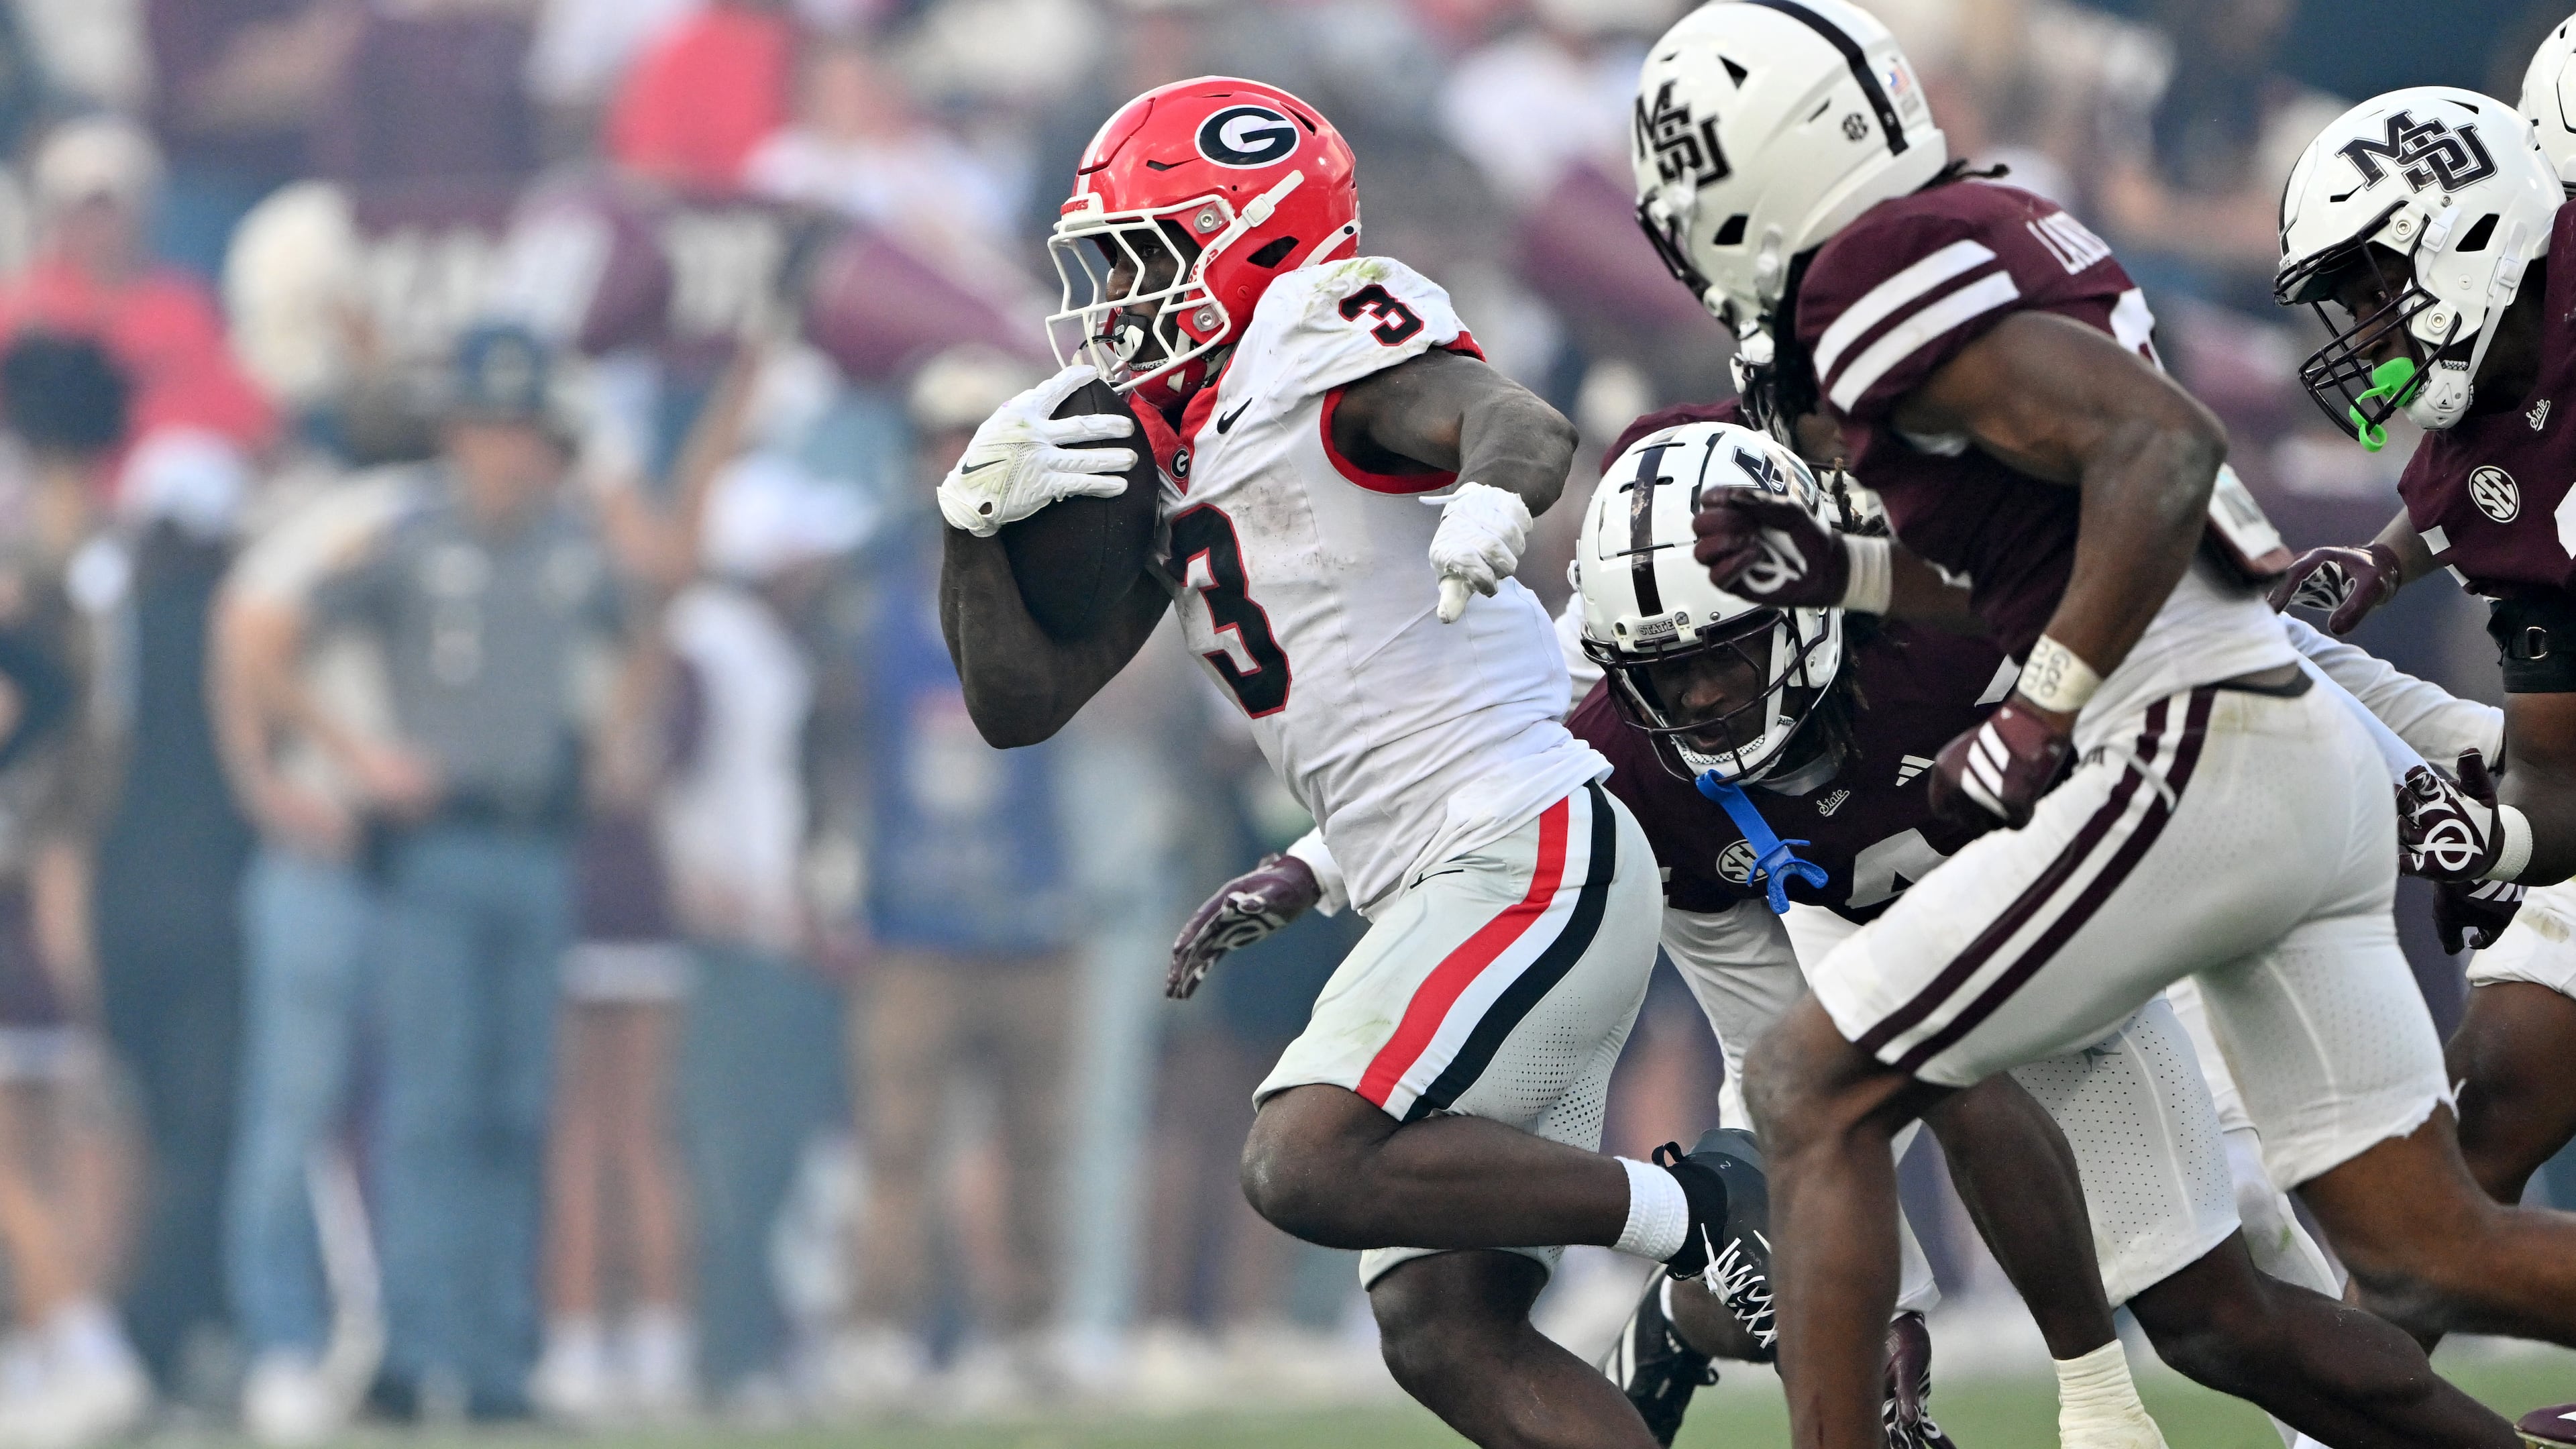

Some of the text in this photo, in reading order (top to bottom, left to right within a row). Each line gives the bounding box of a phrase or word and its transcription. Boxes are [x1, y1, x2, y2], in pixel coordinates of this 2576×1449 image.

[1196, 105, 1299, 168] G
[2335, 109, 2498, 193] MSU
[1338, 284, 1425, 346] 3
[2526, 398, 2551, 431] State
[1170, 447, 1190, 478] G
[2471, 468, 2518, 520] SEC
[1164, 502, 1293, 719] 3
[1638, 619, 1676, 635] STATE
[1816, 789, 1850, 817] State
